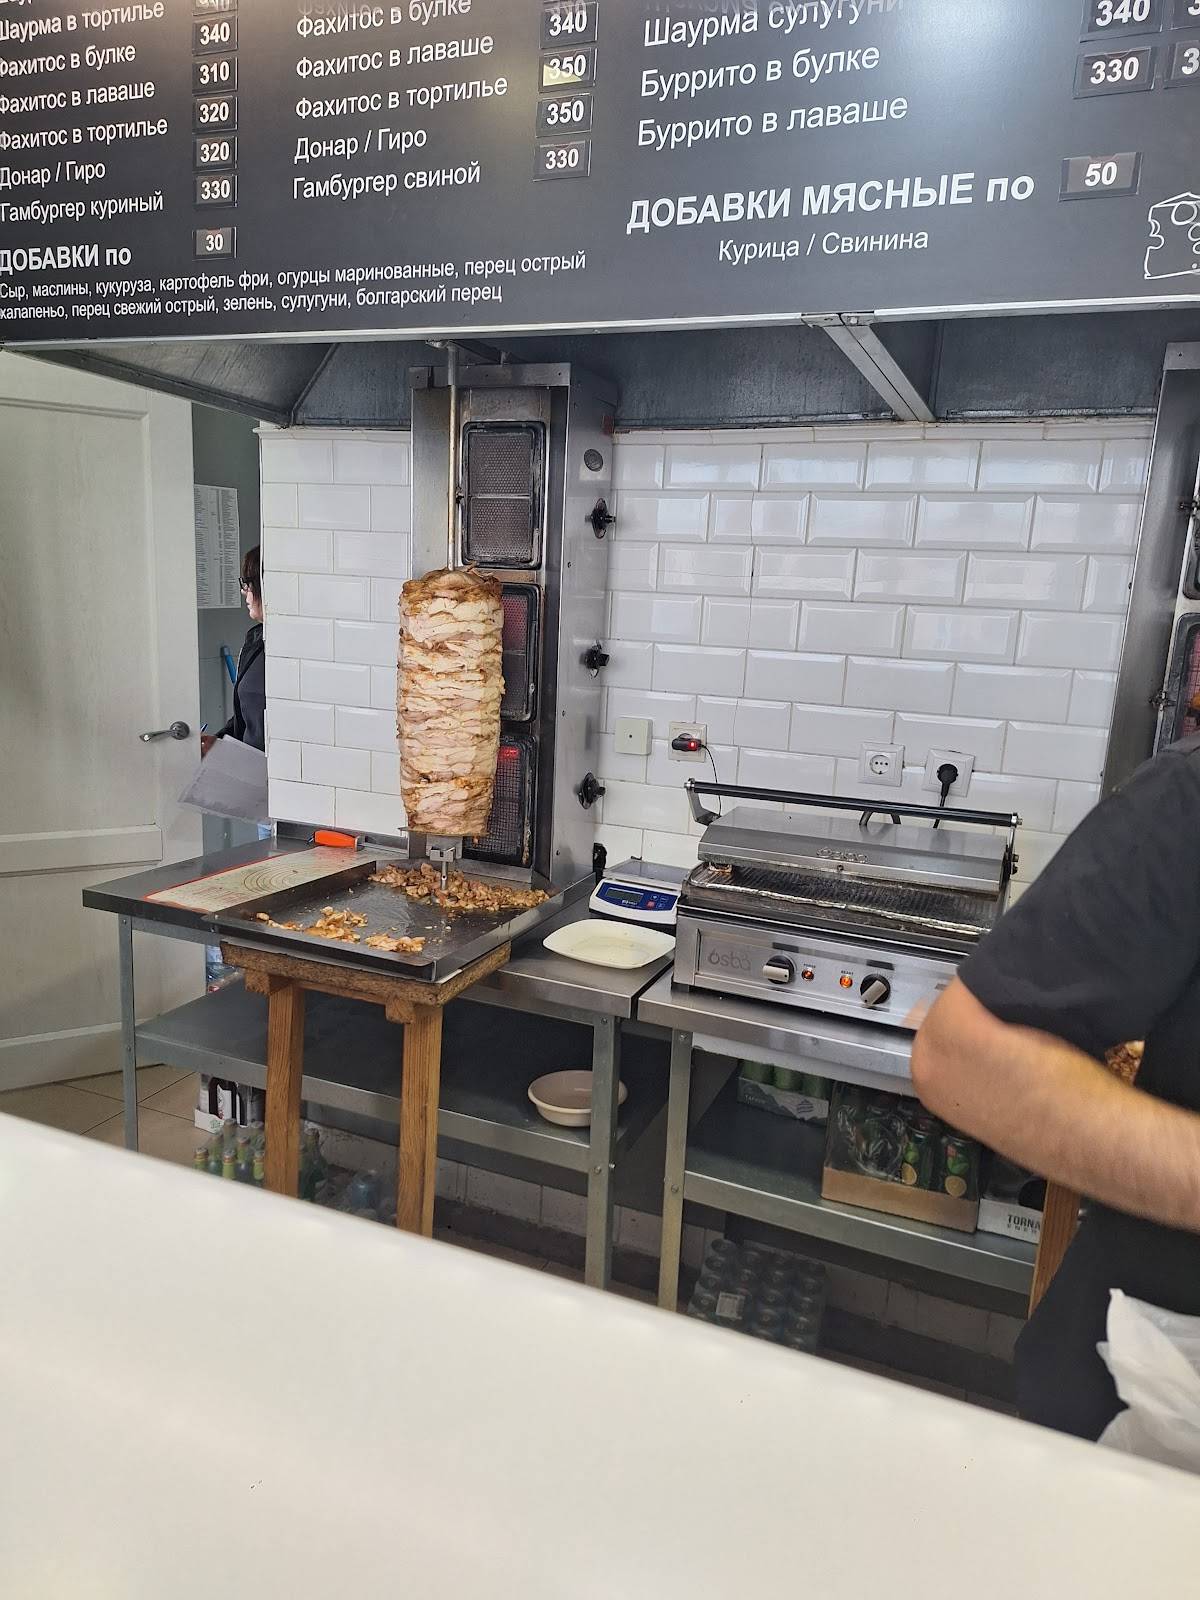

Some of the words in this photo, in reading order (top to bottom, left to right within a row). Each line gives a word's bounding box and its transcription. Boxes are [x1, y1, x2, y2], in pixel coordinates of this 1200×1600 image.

[66, 14, 78, 31] в
[82, 1, 165, 31] тортилье
[296, 13, 384, 38] Фахитос
[390, 6, 402, 25] в
[408, 0, 472, 26] булке
[549, 10, 588, 37] 340
[1095, 0, 1151, 27] 340
[199, 21, 230, 46] 340
[644, 9, 758, 48] Шаурма
[70, 52, 81, 69] в
[85, 44, 136, 71] булке
[296, 51, 383, 79] Фахитос
[389, 49, 401, 67] в
[406, 35, 494, 65] лаваше
[548, 54, 588, 81] 350
[1090, 56, 1140, 85] 330
[199, 61, 230, 85] 310
[640, 63, 757, 102] Буррито
[766, 59, 782, 82] в
[792, 47, 880, 84] булке
[71, 90, 82, 107] в
[85, 81, 155, 105] лаваше
[295, 93, 382, 120] Фахитос
[388, 91, 400, 109] в
[406, 77, 508, 110] тортилье
[199, 101, 230, 124] 320
[546, 99, 585, 126] 350
[637, 114, 753, 152] Буррито
[761, 112, 778, 133] в
[786, 97, 908, 131] лаваше
[72, 128, 83, 144] в
[86, 118, 168, 146] тортилье
[200, 141, 230, 163] 320
[293, 136, 359, 165] Донар
[377, 127, 427, 155] Гиро
[545, 148, 579, 170] 330
[65, 160, 106, 185] Гиро
[293, 173, 398, 201] Гамбургер
[403, 160, 481, 190] свиной
[1084, 161, 1118, 187] 50
[200, 177, 231, 200] 330
[90, 190, 164, 220] куриный
[626, 187, 791, 235] ДОБАВКИ
[802, 172, 975, 216] МЯСНЫЕ
[986, 175, 1035, 202] по
[204, 232, 226, 253] 30
[718, 239, 800, 266] Курица
[822, 231, 929, 255] Свинина
[105, 247, 132, 266] по
[32, 282, 92, 297] маслины,
[95, 279, 156, 298] кукуруза,
[159, 272, 235, 293] картофель
[238, 269, 273, 291] фри,
[277, 269, 331, 289] огурцы
[334, 262, 459, 286] маринованные,
[464, 258, 516, 277] перец
[520, 249, 586, 274] острый
[71, 303, 111, 320] перец
[113, 297, 162, 316] свежий
[164, 295, 219, 316] острый,
[222, 296, 277, 312] зелень,
[281, 292, 352, 313] сулугуни,
[356, 284, 447, 309] болгарский
[451, 285, 503, 305] перец
[1007, 1214, 1041, 1230] TORNA
